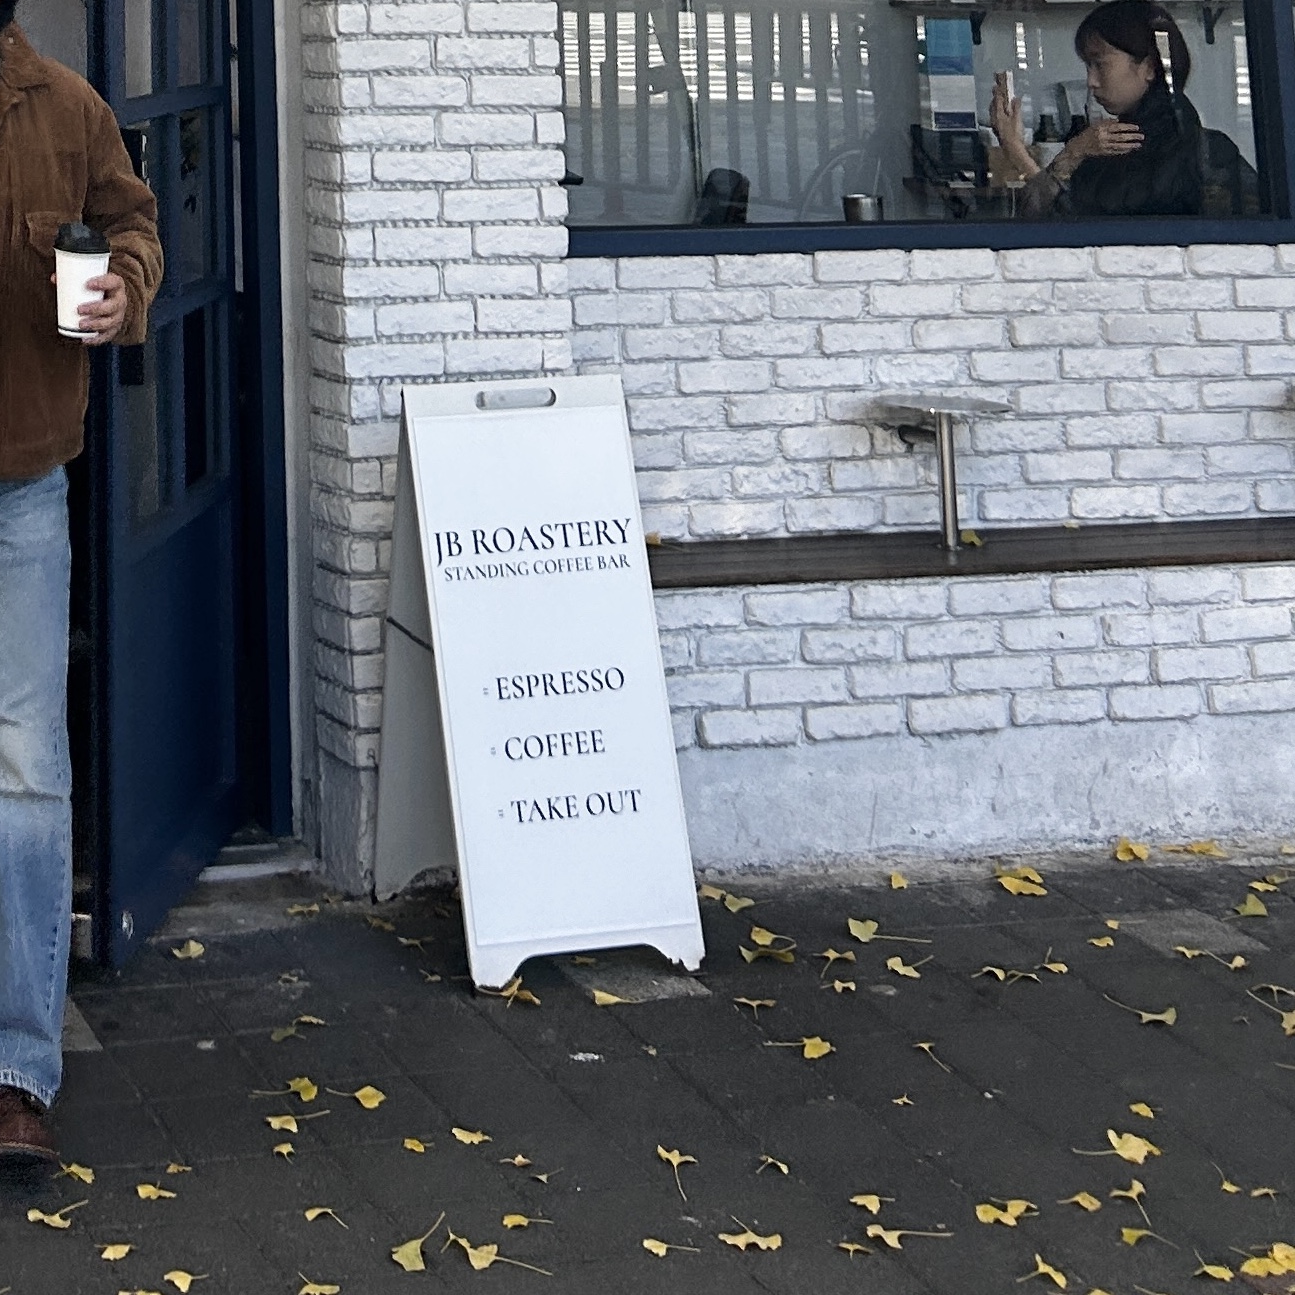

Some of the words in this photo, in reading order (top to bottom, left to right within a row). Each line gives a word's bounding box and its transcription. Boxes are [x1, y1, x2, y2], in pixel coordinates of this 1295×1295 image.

[435, 531, 462, 567] JB
[472, 518, 632, 555] ROASTERY
[444, 560, 529, 582] STANDING
[533, 556, 594, 576] COFFEE
[597, 553, 631, 570] BAR
[495, 667, 625, 700] ESPRESSO
[504, 729, 606, 760] COFFEE
[510, 794, 580, 824] TAKE
[586, 788, 642, 814] OUT
